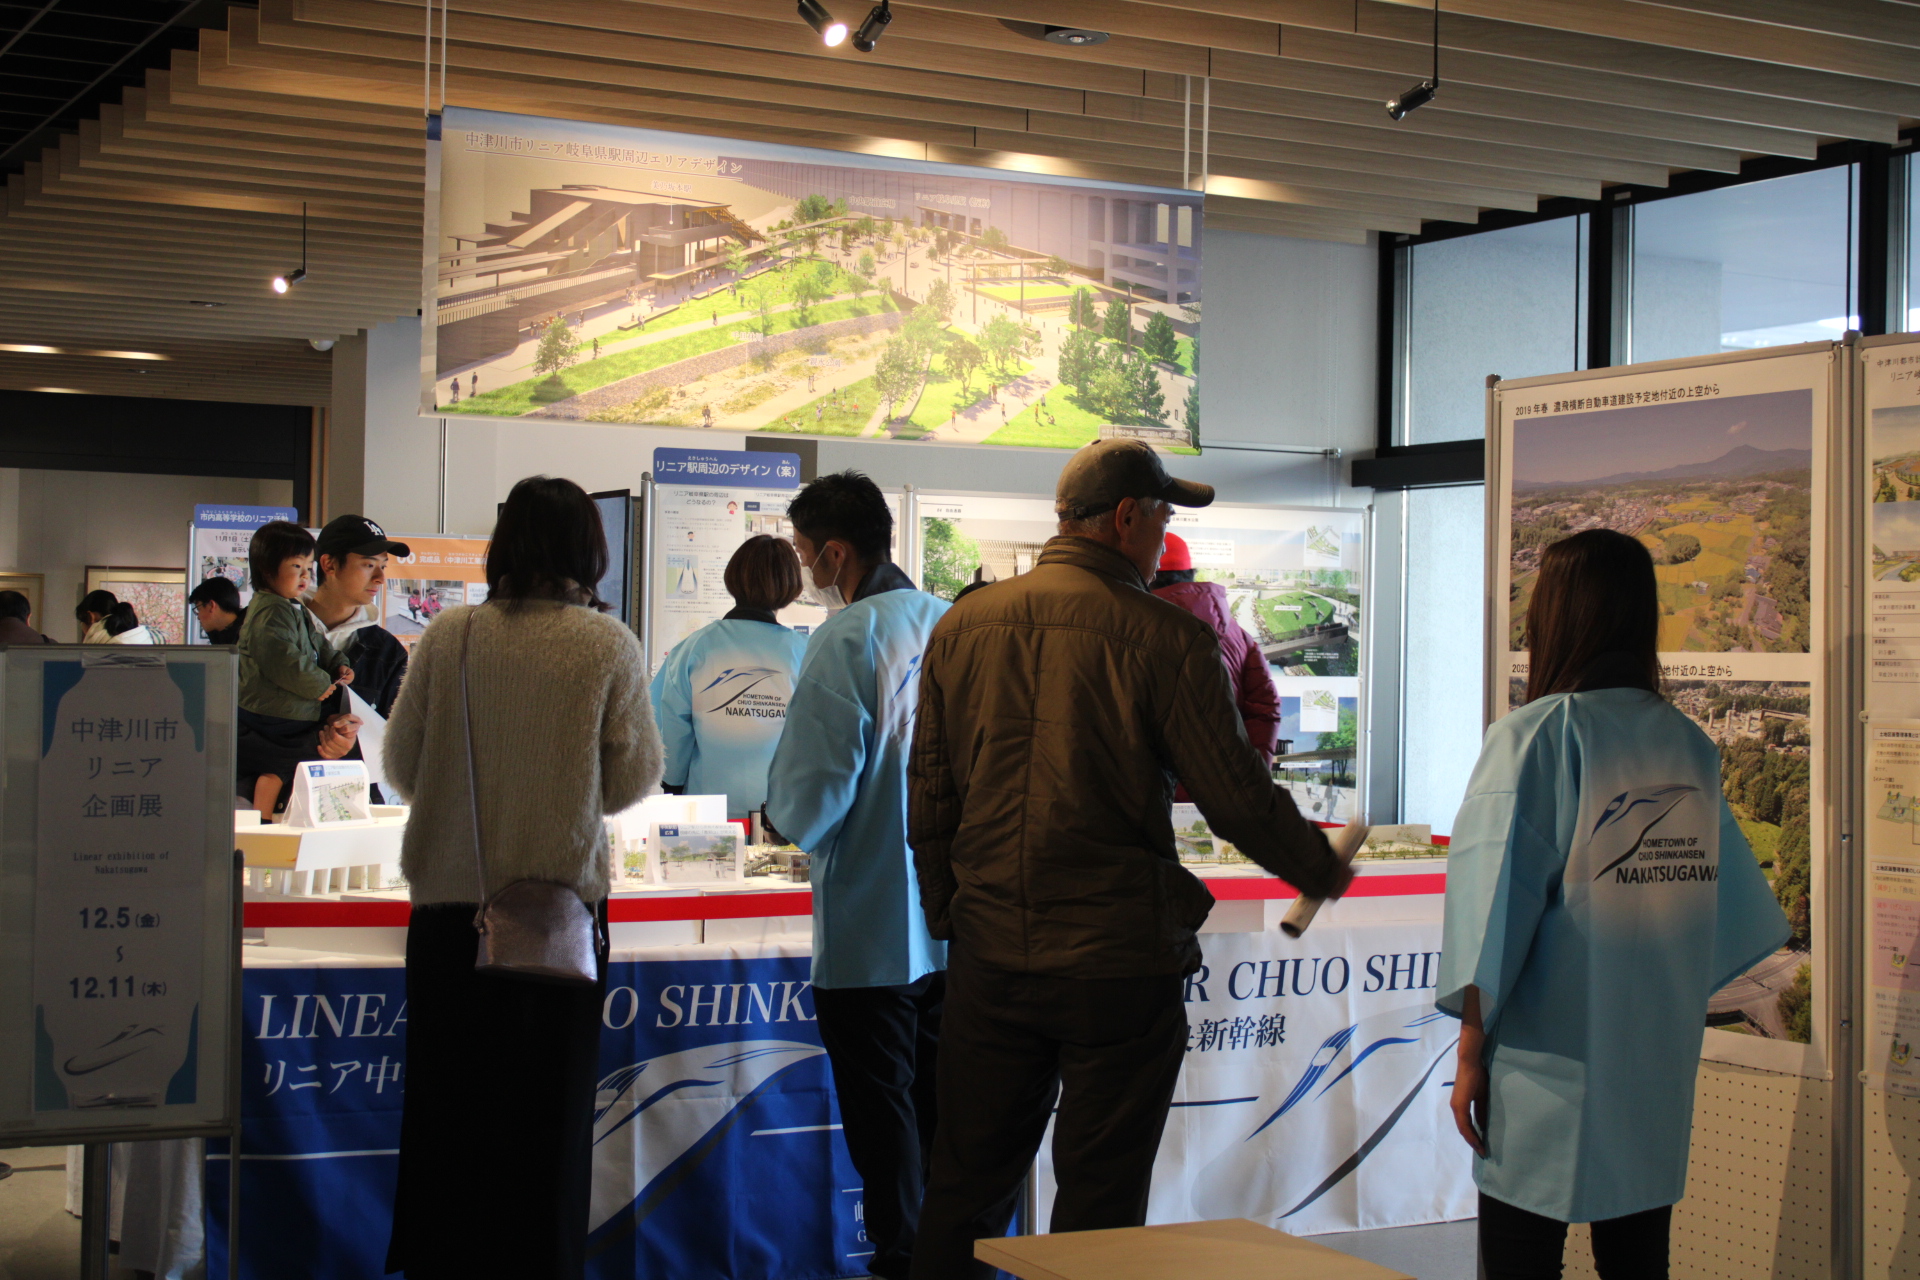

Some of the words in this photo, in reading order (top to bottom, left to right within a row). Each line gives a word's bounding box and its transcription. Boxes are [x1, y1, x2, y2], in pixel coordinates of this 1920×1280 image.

[465, 132, 743, 174] 中津川市リニア岐阜県駅周辺エリアデザイン
[656, 460, 796, 478] リニア駅周辺のデザイン（案）
[363, 521, 384, 536] LA
[71, 717, 178, 742] 中津川市
[88, 756, 162, 779] リニア
[82, 794, 163, 818] 企画展
[1643, 838, 1686, 848] HOMETOWN
[1687, 837, 1698, 847] OF
[73, 852, 102, 861] Linear
[107, 851, 155, 861] exhibition
[159, 851, 169, 860] of
[1638, 851, 1654, 862] CHUO
[1654, 850, 1706, 860] SHINKANSEN
[95, 865, 148, 874] Nakatsugawa
[1228, 956, 1351, 1001] CHUO
[1363, 951, 1442, 993] SHI
[656, 981, 818, 1028] SHINK
[264, 1055, 405, 1097] リニア中
